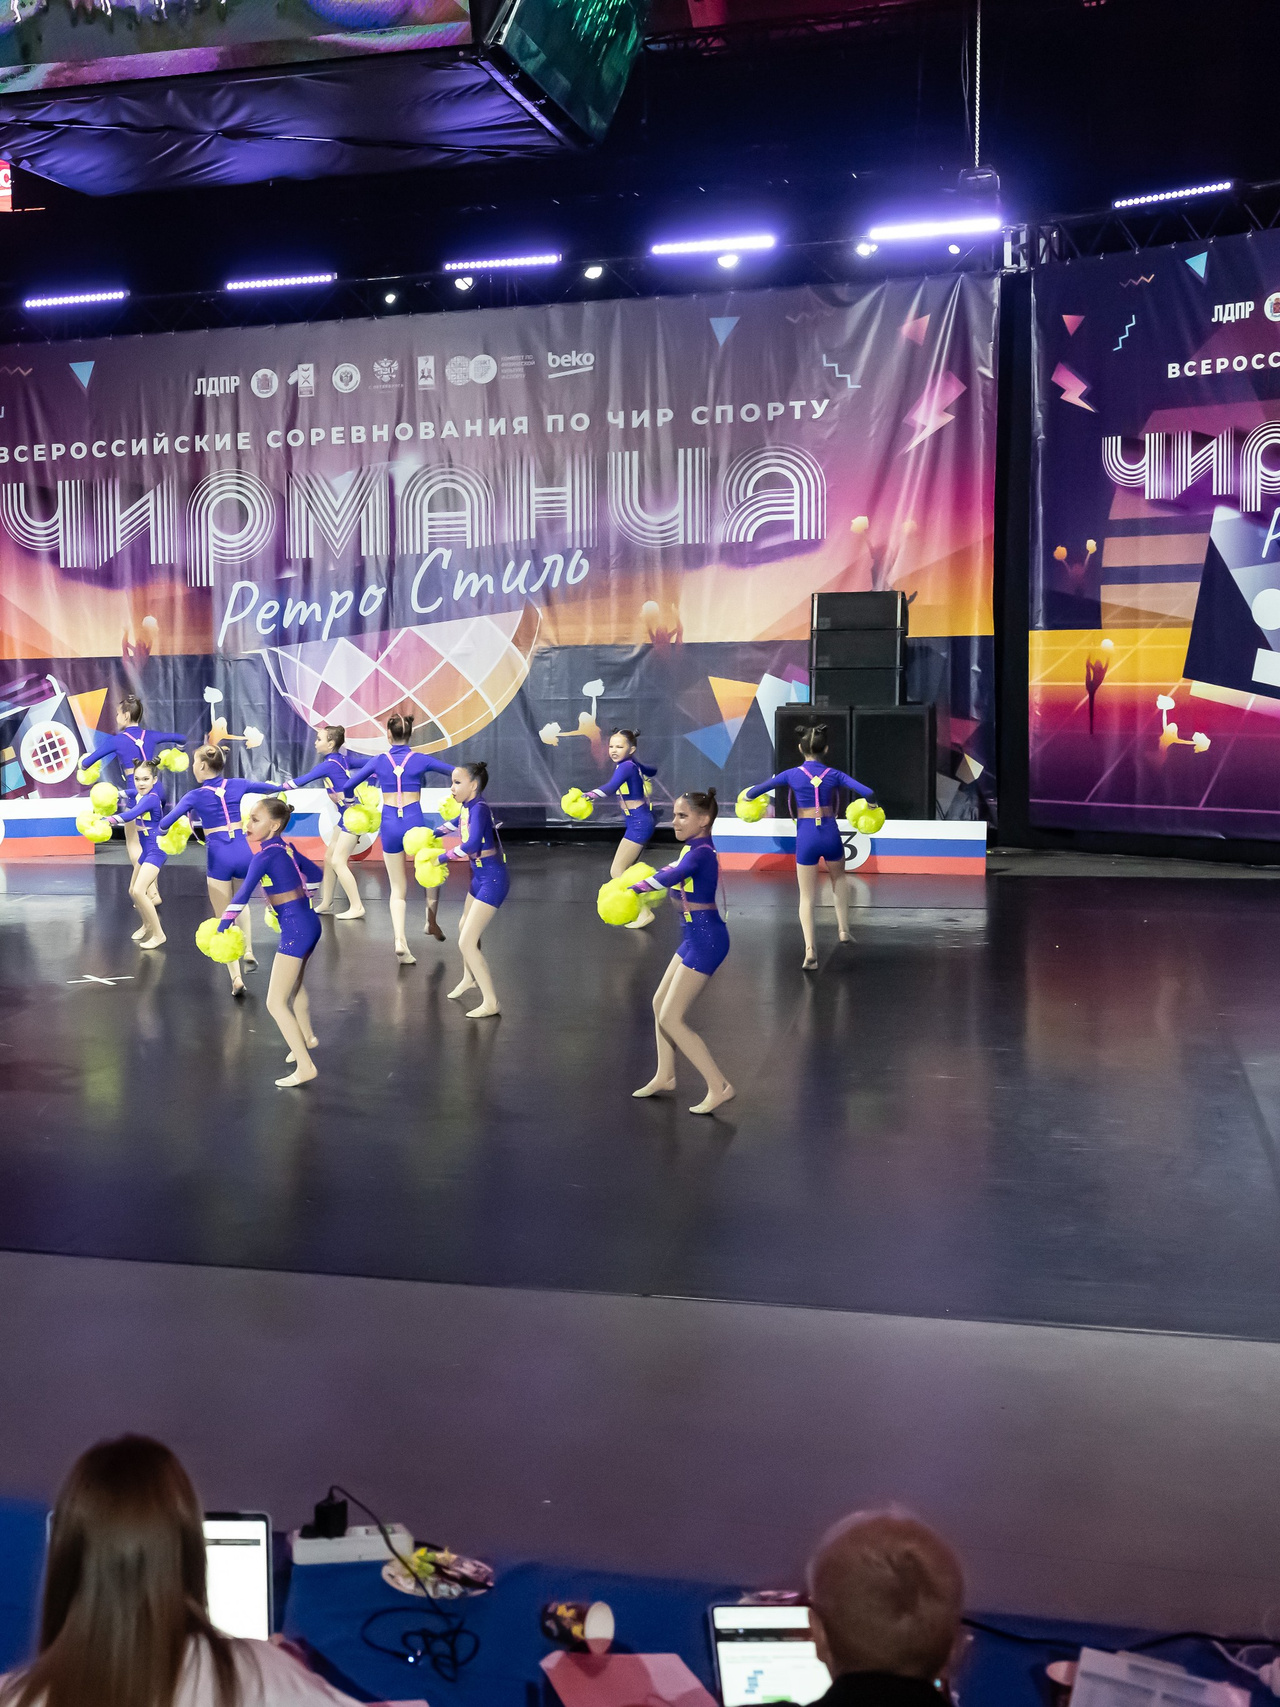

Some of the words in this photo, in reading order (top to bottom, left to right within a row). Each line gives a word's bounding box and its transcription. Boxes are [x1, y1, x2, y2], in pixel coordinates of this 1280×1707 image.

[1211, 301, 1255, 323] ЛДПР
[548, 350, 595, 368] beko
[194, 376, 240, 397] ЛДПР
[266, 416, 528, 448] СОРЕВНОВАНИЯ
[546, 412, 591, 433] ПО
[607, 408, 674, 429] ЧИР
[691, 399, 830, 425] СПОРТУ
[217, 580, 387, 648] Ретро
[410, 547, 590, 614] Стиль
